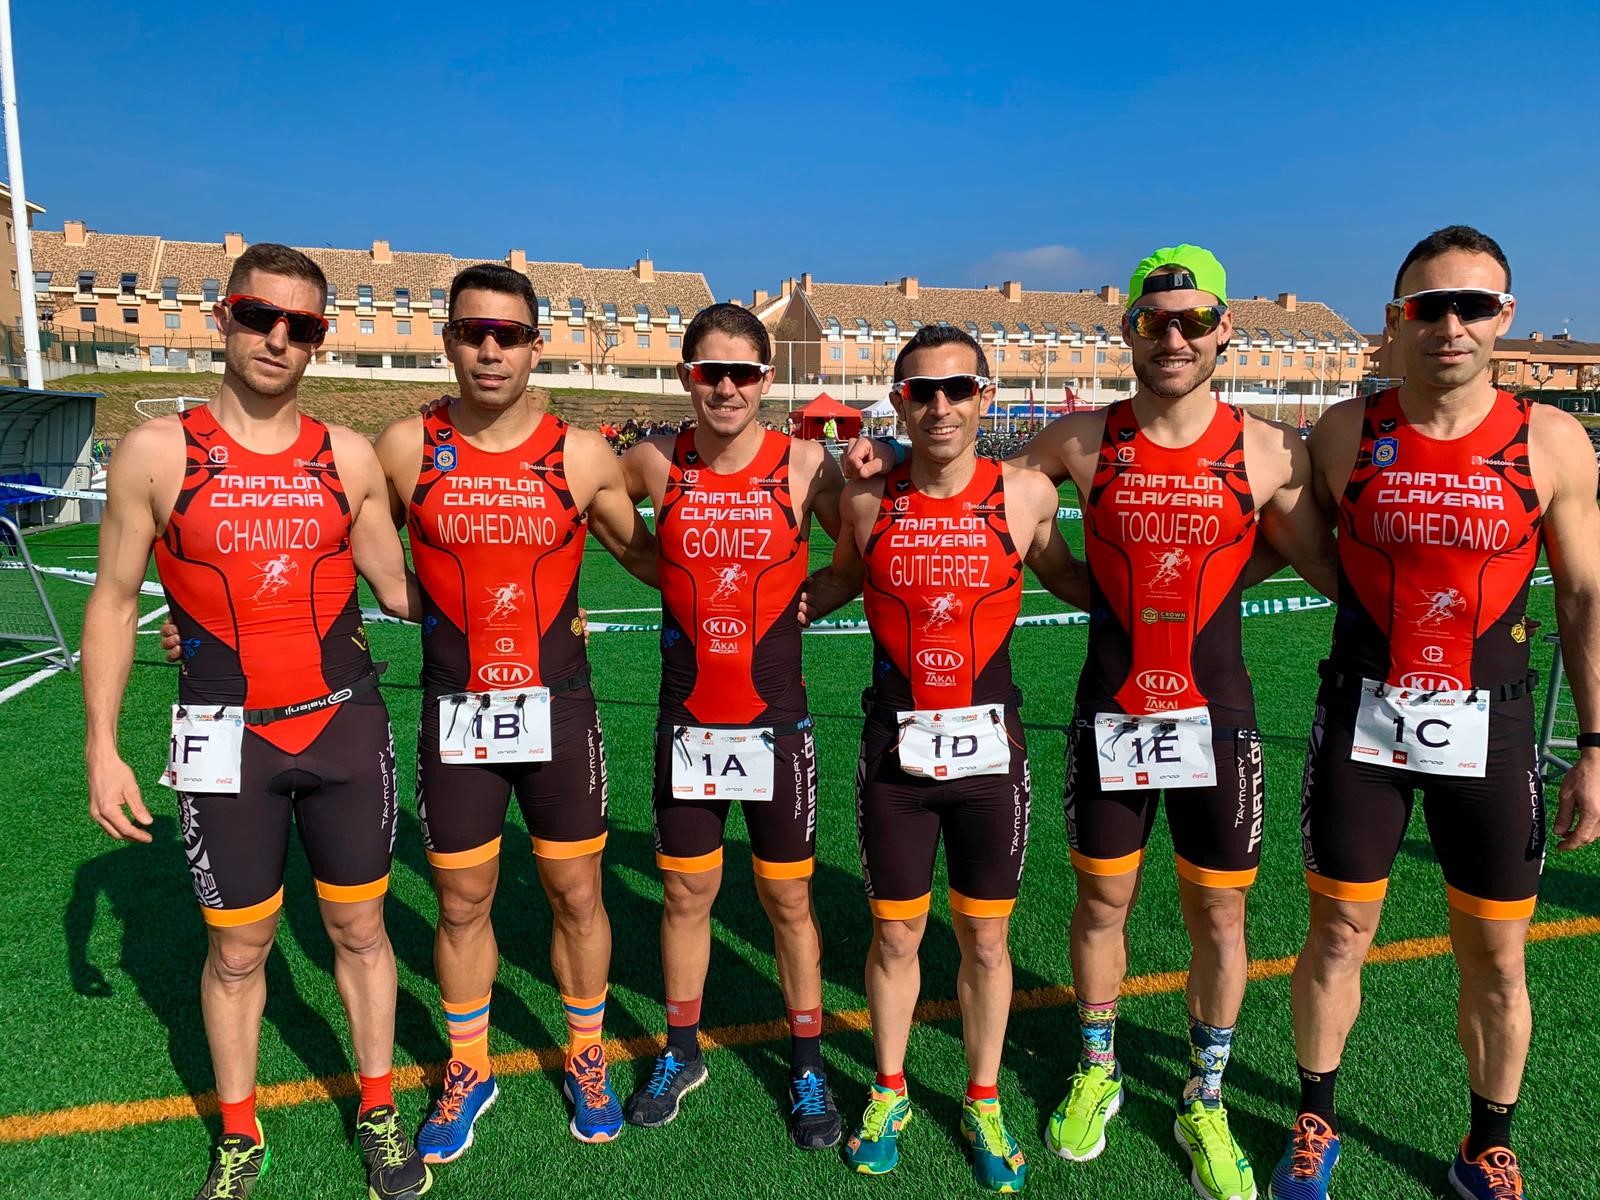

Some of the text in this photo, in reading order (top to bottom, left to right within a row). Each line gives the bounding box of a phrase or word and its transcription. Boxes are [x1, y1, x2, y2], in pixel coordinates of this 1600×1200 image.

[213, 472, 321, 490] TRIATLÓN
[446, 476, 544, 493] TRIATLÓN
[1118, 472, 1224, 491] TRIATLÓN
[1382, 472, 1503, 492] TRIATLÓN
[210, 489, 324, 507] CLAVERÍA
[443, 492, 546, 509] CLAVERÍA
[684, 488, 771, 505] TRIATLÓN
[1115, 490, 1224, 508] CLAVERÍA
[1377, 489, 1505, 510] CLAVERÍA
[680, 504, 773, 520] CLAVERÍA
[437, 514, 556, 546] MOHEDANO
[895, 514, 986, 531] TRIATLÓN
[1117, 511, 1220, 545] TOQUERO
[1373, 511, 1510, 551] MOHEDANO
[216, 518, 321, 554] CHAMIZO
[682, 523, 771, 560] GÓMEZ
[890, 530, 987, 548] CLAVERÍA
[890, 548, 990, 587] GUTIÉRREZ
[709, 621, 738, 634] KIA
[710, 639, 738, 650] TAKAI
[923, 654, 955, 666] KIA
[487, 667, 524, 681] KIA
[926, 672, 956, 683] TAKAI
[1145, 675, 1181, 691] KIA
[1410, 676, 1452, 691] KIA
[1145, 696, 1178, 709] TAKAI
[587, 729, 597, 794] TAYMORY
[378, 751, 390, 829] TAYMORY
[792, 753, 802, 819] TAYMORY
[1235, 756, 1247, 828] TAYMORY
[1527, 770, 1539, 849] TAYMORY
[1010, 784, 1021, 855] TAYMORY
